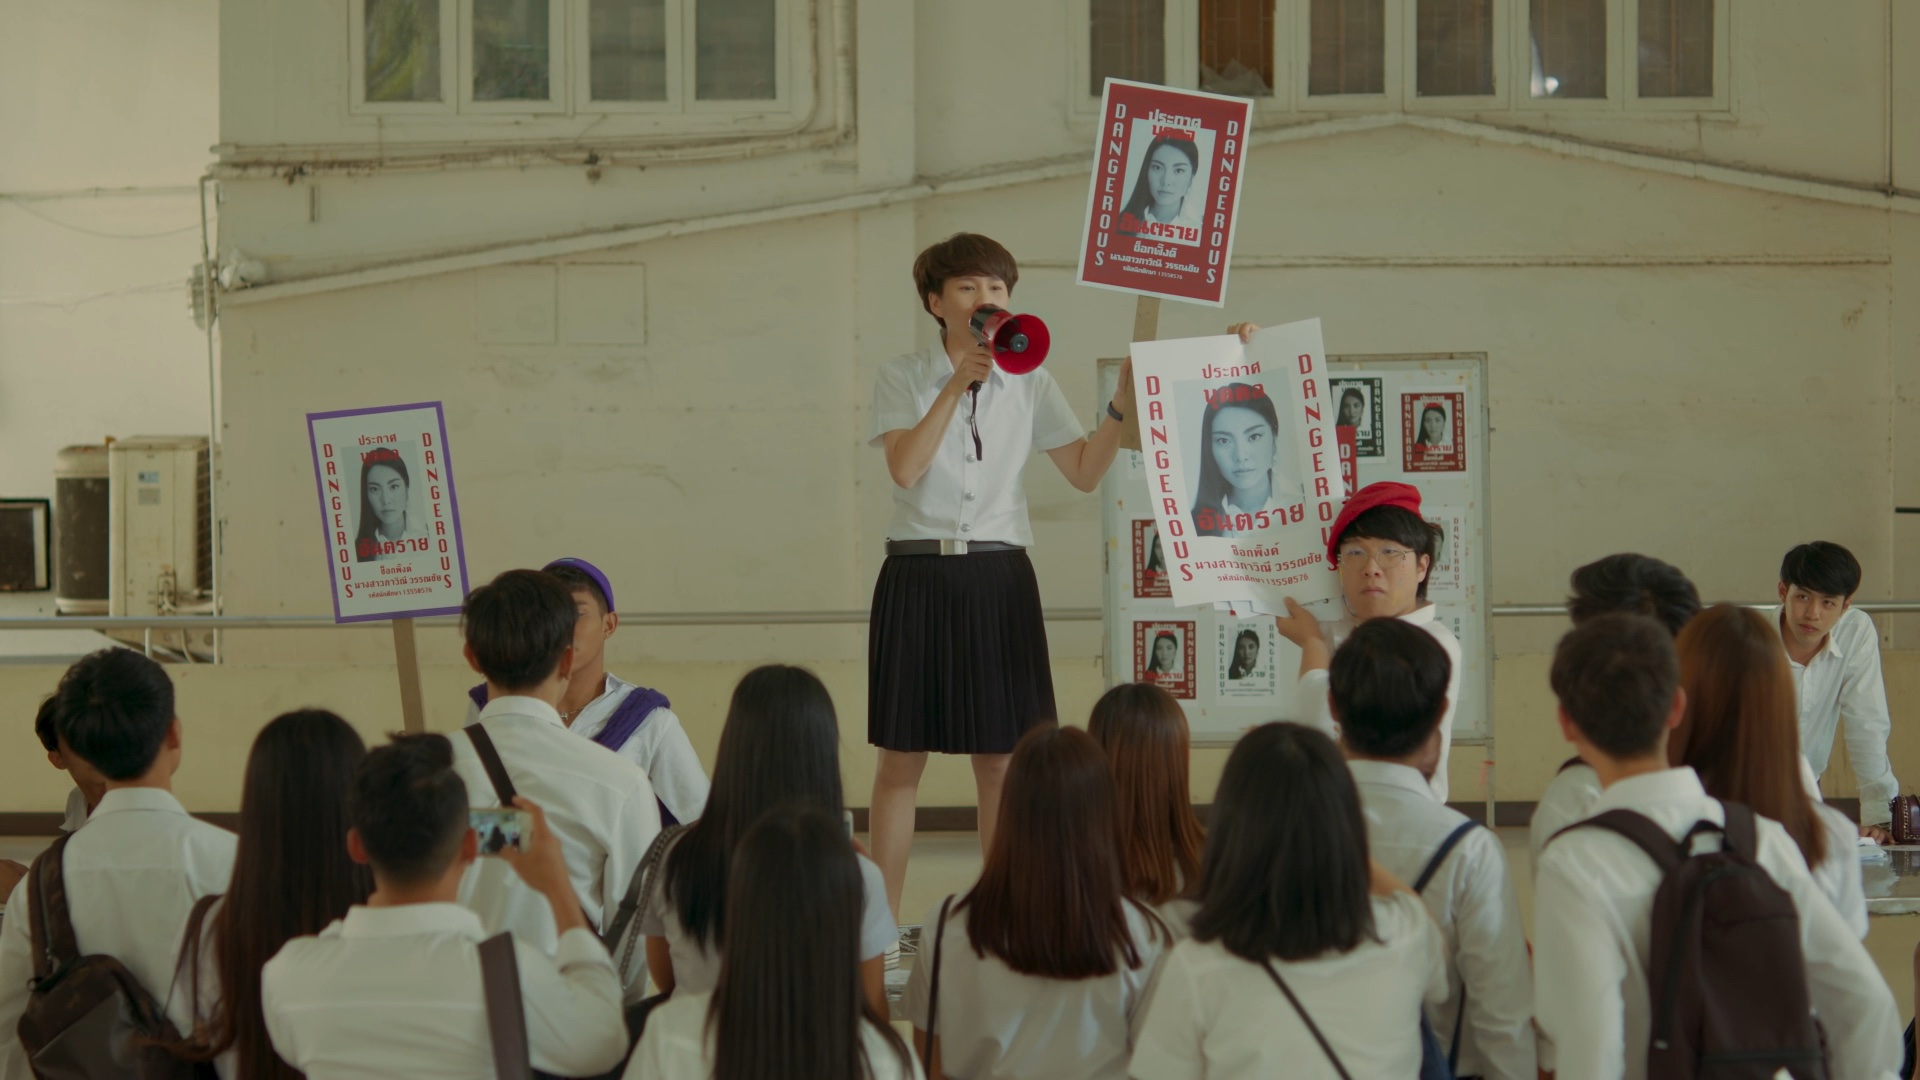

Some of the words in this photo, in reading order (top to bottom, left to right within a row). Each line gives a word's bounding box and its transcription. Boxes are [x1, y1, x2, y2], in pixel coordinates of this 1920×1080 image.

[1148, 108, 1202, 129] ประกาศ
[1095, 103, 1127, 267] DANGEROUS
[1206, 120, 1239, 284] DANGEROUS
[1201, 361, 1261, 380] ประกาศ
[1203, 382, 1265, 411] บุคคล
[358, 433, 397, 446] ประกาศ
[1374, 379, 1382, 455] DANGEROUS
[1405, 394, 1413, 471] DANGEROUS
[1456, 393, 1465, 470] DANGEROUS
[422, 432, 453, 589] DANGEROUS
[1145, 375, 1194, 582] DANGEROUS
[323, 443, 355, 599] DANGEROUS
[357, 536, 429, 557] อันตราย
[1198, 502, 1305, 532] อันตราย
[1134, 521, 1144, 597] DANGEROUS
[1275, 553, 1322, 573] วรรณชัย
[1187, 622, 1195, 697] DANGEROUS
